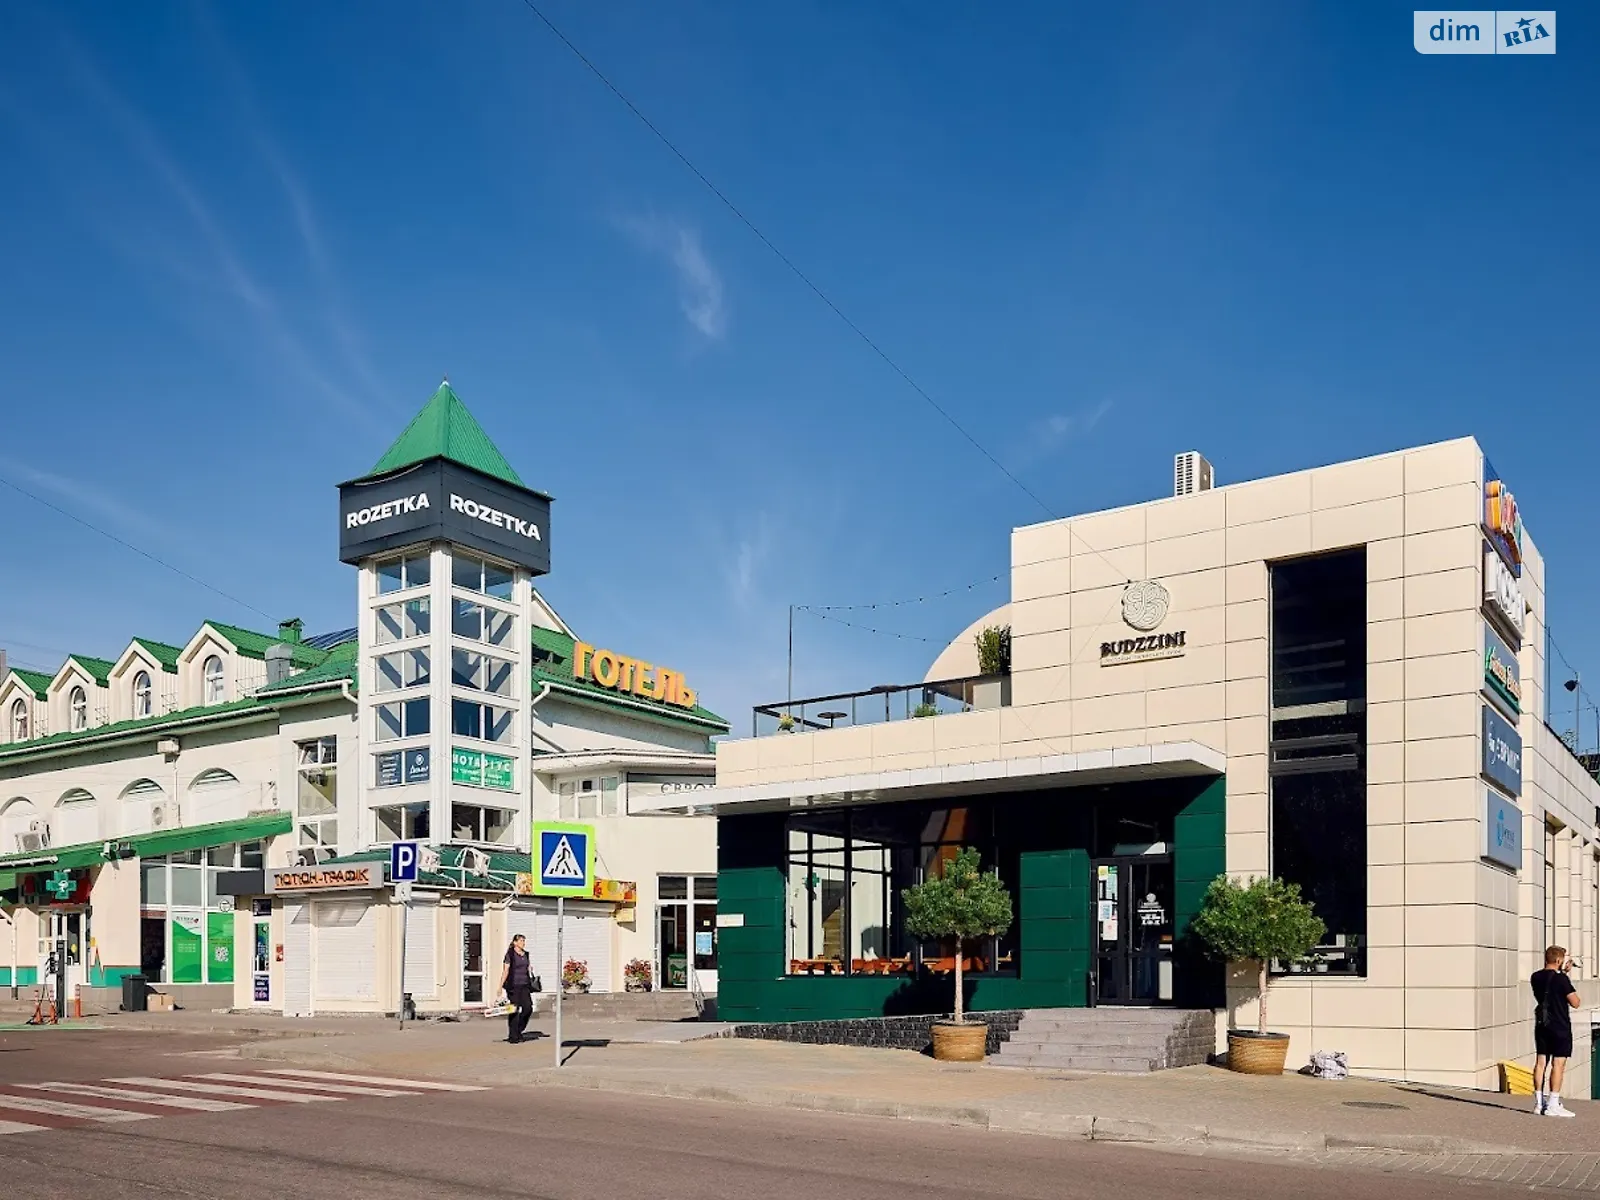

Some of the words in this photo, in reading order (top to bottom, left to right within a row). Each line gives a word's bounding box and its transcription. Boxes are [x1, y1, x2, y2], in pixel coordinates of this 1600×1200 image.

[346, 492, 430, 529] ROZETKA
[449, 493, 542, 542] ROZETKA
[1099, 630, 1187, 659] BUDZZINI
[573, 641, 696, 709] ГОТЕЛЬ
